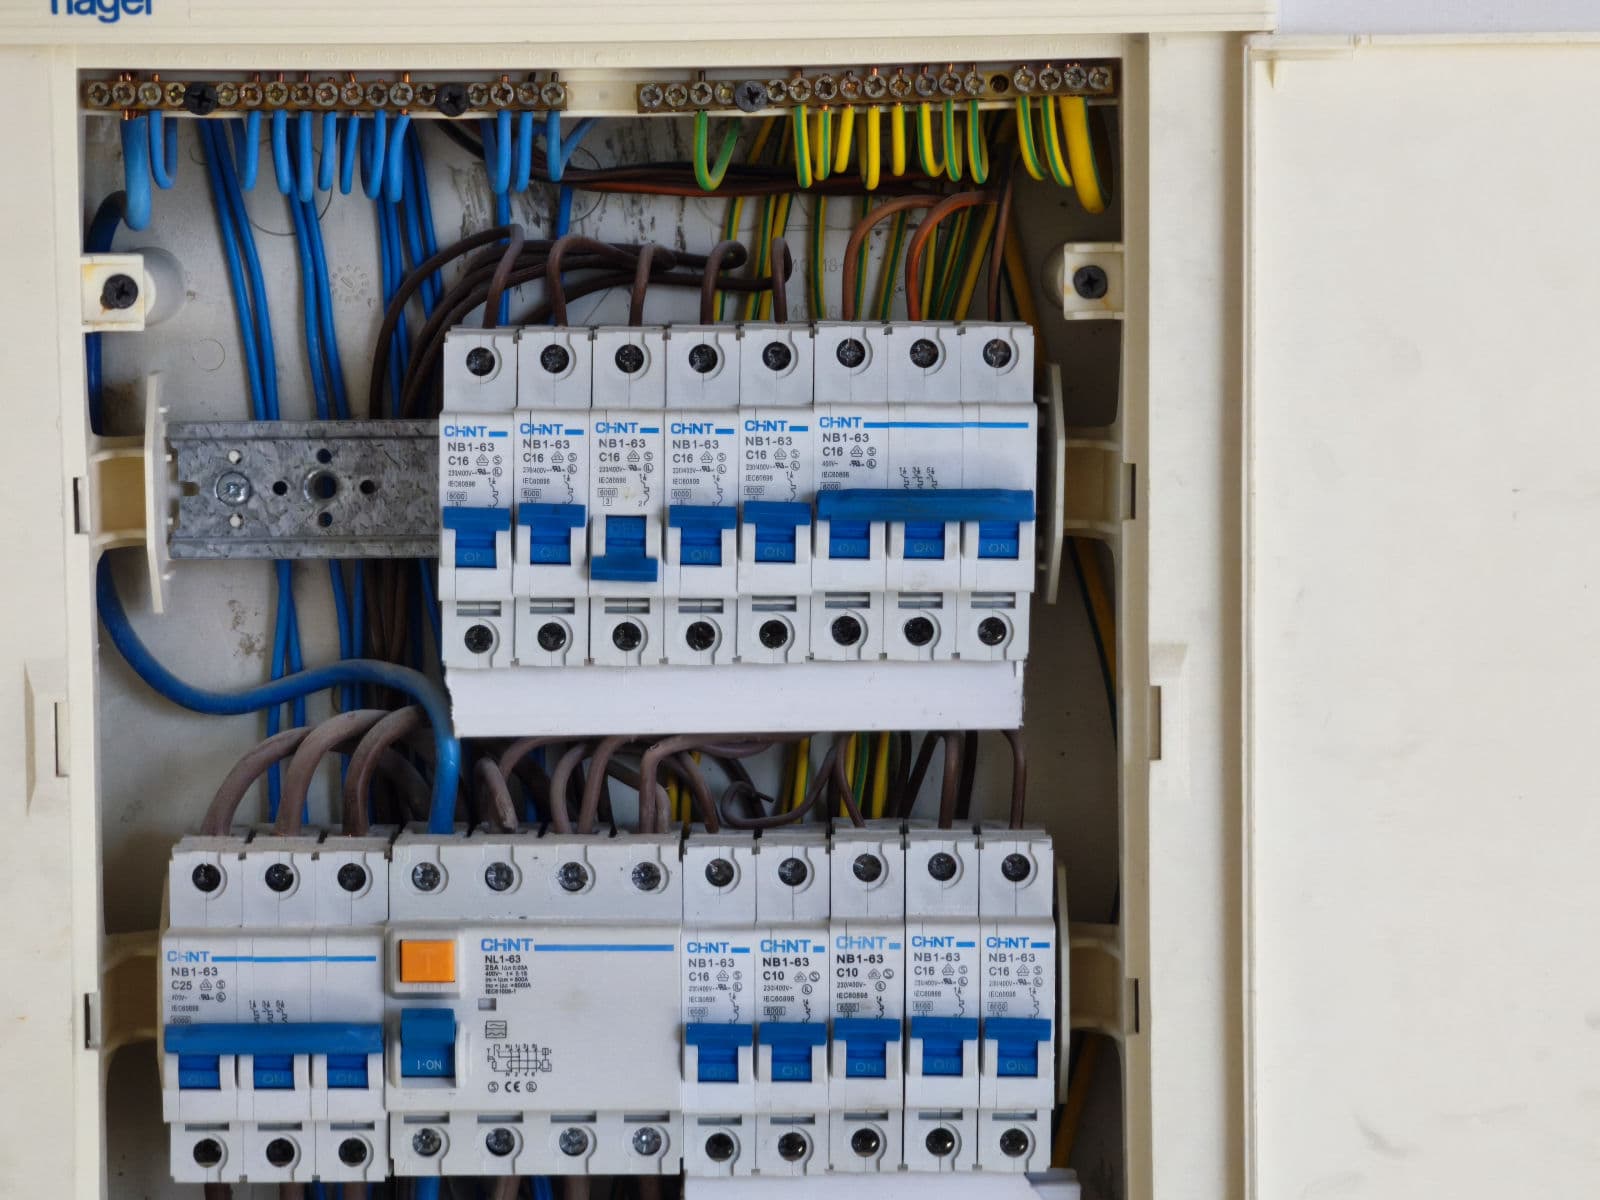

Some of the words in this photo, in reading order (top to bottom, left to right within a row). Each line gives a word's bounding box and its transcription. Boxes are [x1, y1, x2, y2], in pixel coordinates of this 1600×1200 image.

[745, 437, 792, 446] NB1-63
[822, 433, 869, 442] NB1-63
[448, 442, 495, 452] NB1-63
[522, 439, 570, 449] NB1-63
[599, 439, 646, 448] NB1-63
[673, 440, 719, 449] NB1-63
[746, 450, 767, 460] C16
[822, 447, 843, 456] C16
[448, 456, 469, 465] C16
[523, 453, 544, 462] C16
[599, 452, 620, 462] C16
[673, 453, 693, 463] C16
[485, 955, 521, 963] NL1-63
[837, 954, 884, 964] NB1-63
[914, 953, 960, 961] NB1-63
[989, 953, 1035, 962] NB1-63
[688, 959, 734, 967] NB1-63
[763, 958, 809, 967] NB1-63
[171, 967, 218, 976] NB1-63
[837, 968, 858, 977] C10
[914, 966, 935, 975] C16
[989, 967, 1009, 976] C16
[689, 972, 709, 981] C16
[763, 971, 784, 980] C10
[171, 981, 192, 990] C25
